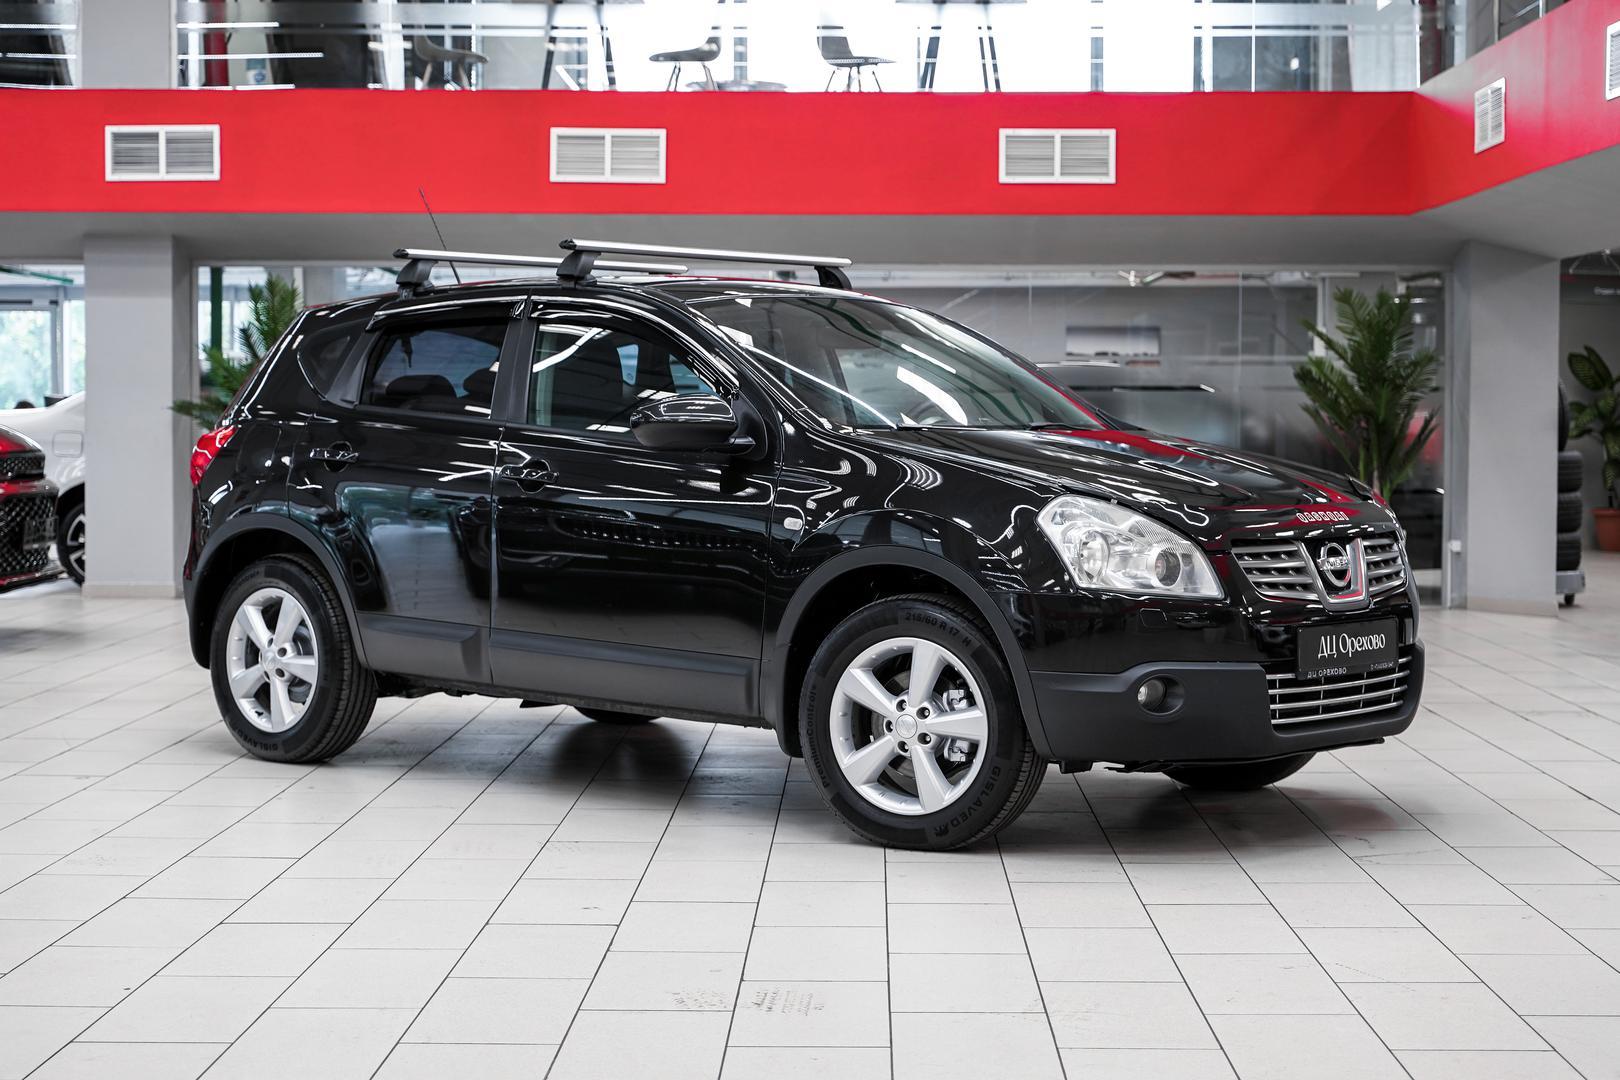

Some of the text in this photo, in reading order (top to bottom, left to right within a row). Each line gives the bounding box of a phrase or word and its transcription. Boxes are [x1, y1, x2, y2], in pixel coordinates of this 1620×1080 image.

[1296, 511, 1350, 523] QASHQAI
[941, 620, 949, 631] R
[950, 626, 960, 636] 17
[1318, 632, 1386, 659] ДЦ Орехово
[1318, 666, 1347, 678] ОРЕХОВО
[950, 765, 1001, 828] GISLAVED
